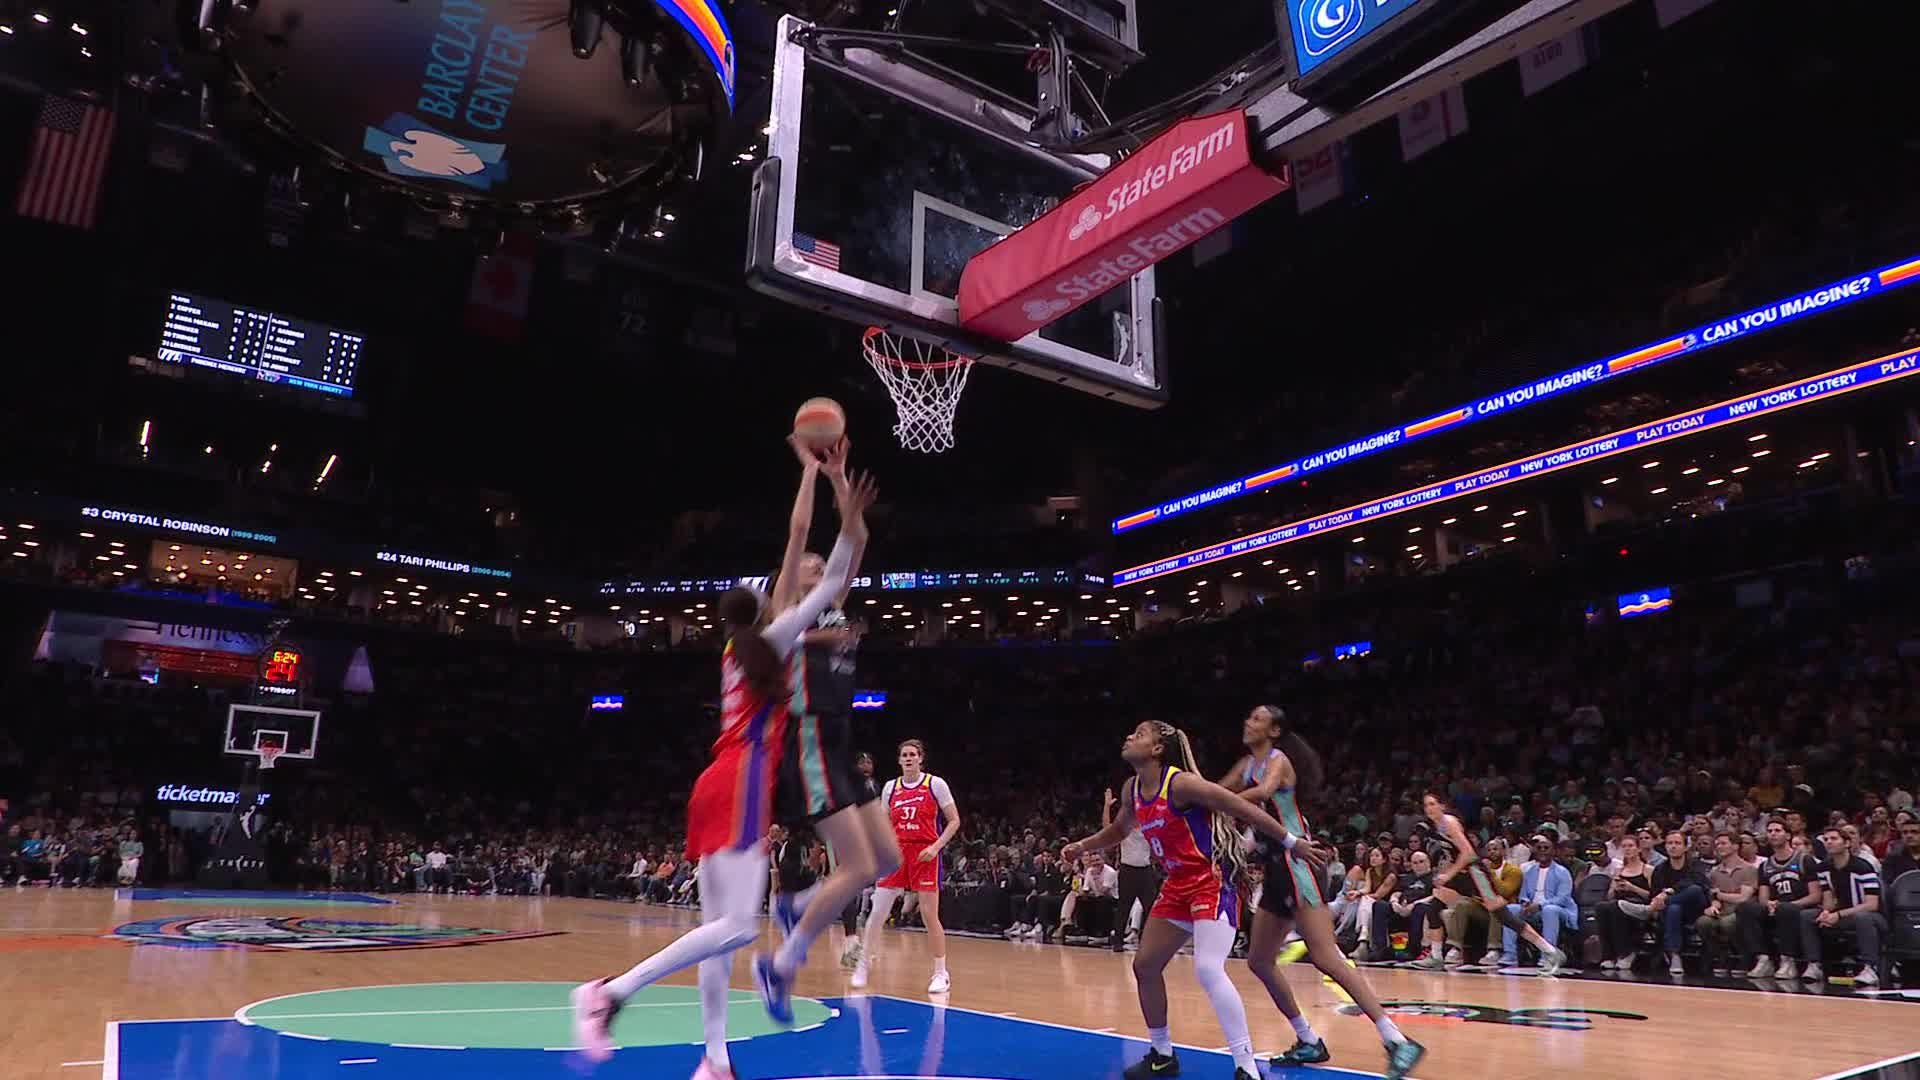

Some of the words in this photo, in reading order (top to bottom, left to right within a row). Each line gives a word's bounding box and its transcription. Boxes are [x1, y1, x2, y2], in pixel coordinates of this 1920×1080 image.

[465, 25, 536, 130] CENTER
[1703, 320, 1738, 342] CAN
[1739, 307, 1777, 330] YOU
[1780, 277, 1872, 319] IMAGINE?
[1881, 355, 1917, 375] PLAY
[1477, 396, 1505, 415] CAN
[1506, 386, 1534, 406] YOU
[1535, 364, 1603, 397] IMAGINE?
[1729, 400, 1758, 417] NEW
[1761, 388, 1798, 407] YORK
[1800, 372, 1858, 397] LOTTERY
[1636, 426, 1664, 442] PLAY
[1666, 414, 1705, 433] TODAY
[1302, 456, 1324, 471] CAN
[1325, 447, 1347, 463] YOU
[1348, 430, 1401, 457] IMAGINE?
[1520, 460, 1544, 474] NEW
[1545, 451, 1574, 467] YORK
[1575, 438, 1620, 459] LOTTERY
[1455, 478, 1478, 492] PLAY
[1479, 469, 1510, 485] TODAY
[1163, 502, 1180, 515] CAN
[1182, 496, 1199, 510] YOU
[1200, 482, 1242, 503] IMAGINE?
[1361, 506, 1380, 517] NEW
[1381, 499, 1405, 512] YORK
[1406, 487, 1442, 505] LOTTERY
[81, 506, 99, 518] #3
[102, 509, 160, 527] CRYSTAL
[162, 518, 229, 537] ROBINSON
[1308, 519, 1327, 532] PLAY
[1328, 512, 1354, 526] TODAY
[1231, 542, 1248, 552] NEW
[1249, 536, 1267, 548] YORK
[1268, 527, 1298, 542] LOTTERY
[377, 552, 397, 562] #24
[399, 554, 423, 566] TARI
[425, 558, 470, 573] PHILLIPS
[1188, 553, 1203, 564] PLAY
[1204, 547, 1225, 559] TODAY
[1124, 571, 1138, 581] NEW
[1138, 567, 1155, 577] YORK
[1155, 560, 1179, 574] LOTTERY
[273, 651, 299, 664] 6:24
[265, 661, 296, 682] 24
[901, 807, 917, 820] 37
[1151, 837, 1164, 857] 8
[1776, 880, 1793, 894] 20
